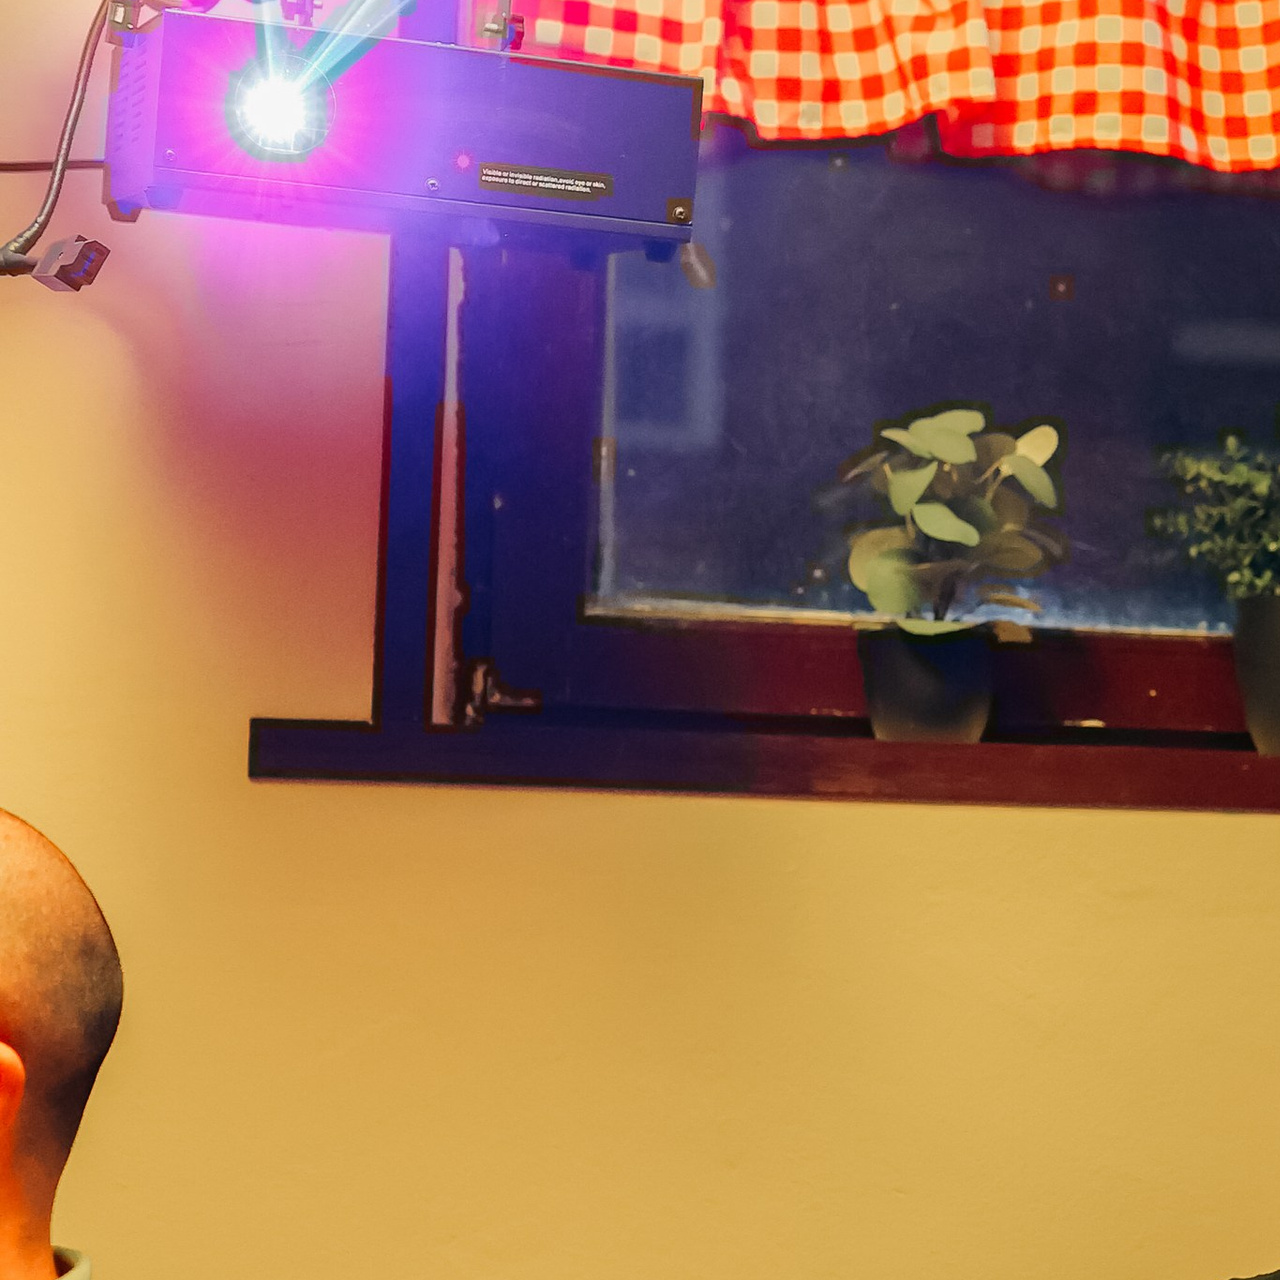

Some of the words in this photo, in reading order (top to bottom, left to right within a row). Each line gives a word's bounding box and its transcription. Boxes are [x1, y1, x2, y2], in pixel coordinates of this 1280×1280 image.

[482, 168, 502, 176] Visible
[509, 171, 532, 179] invisible
[481, 175, 507, 183] exposure
[538, 182, 565, 190] scattered
